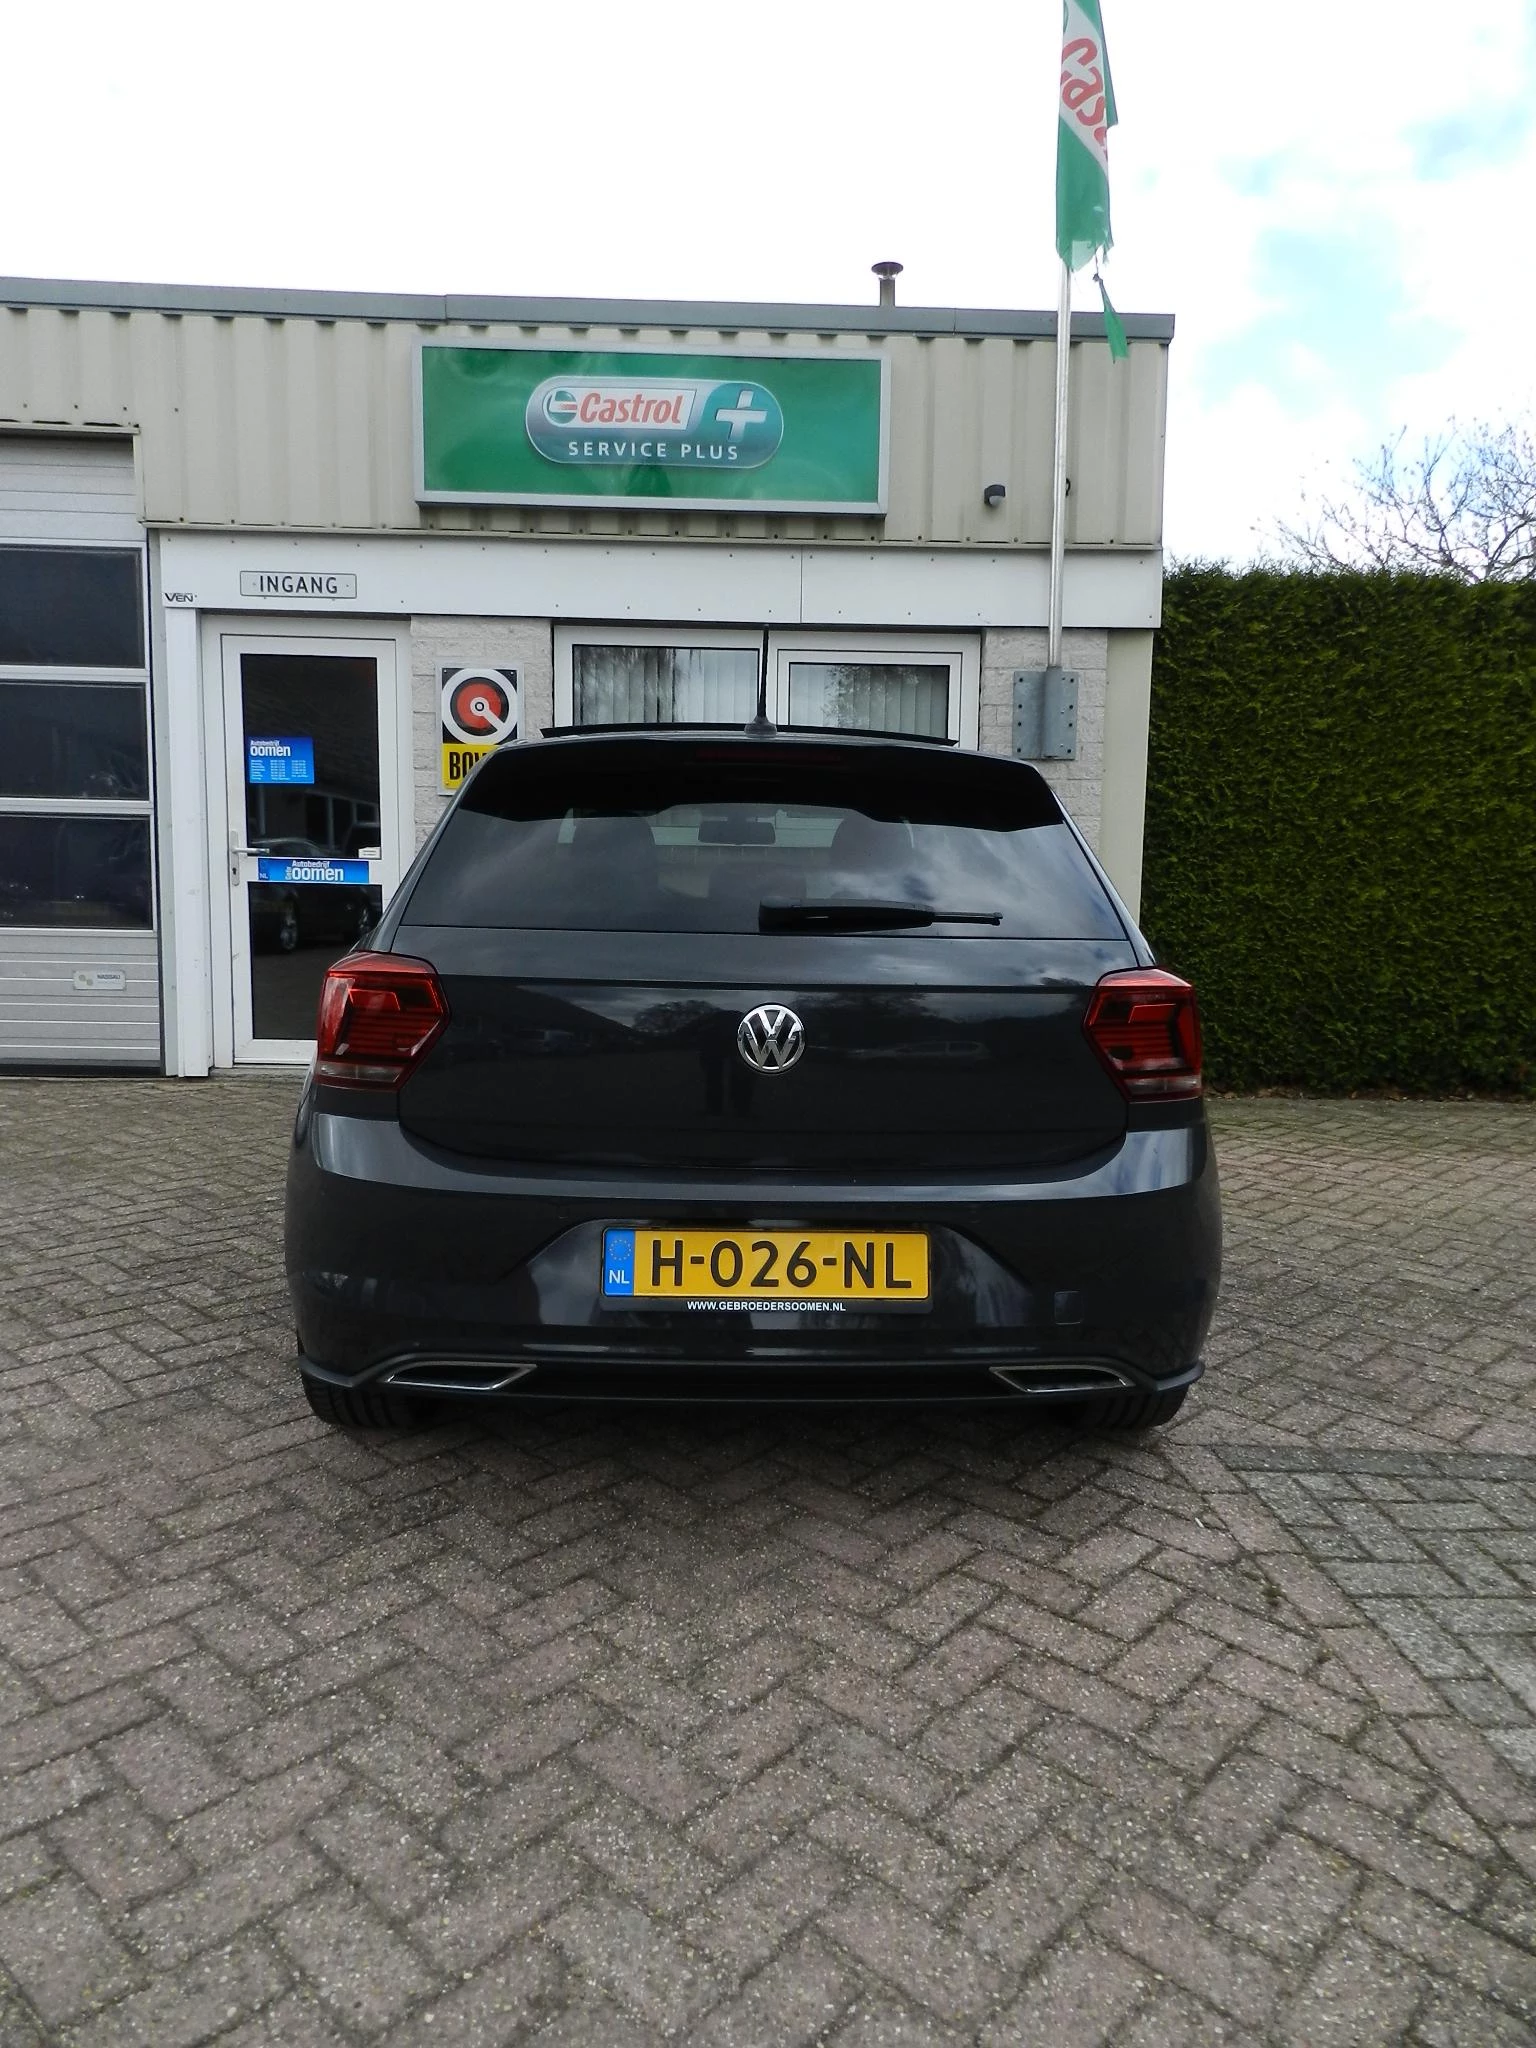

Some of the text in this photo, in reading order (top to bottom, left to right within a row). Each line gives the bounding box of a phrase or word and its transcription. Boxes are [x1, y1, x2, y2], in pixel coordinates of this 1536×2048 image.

[579, 392, 684, 425] Castrol
[568, 440, 738, 461] SERVICE PLUS
[259, 575, 338, 595] INGANG
[292, 867, 344, 881] oomen
[651, 1239, 912, 1289] H-026-NL
[608, 1269, 630, 1284] NL
[687, 1300, 846, 1312] WWW.GEBROEDERSOOMEN.NL
